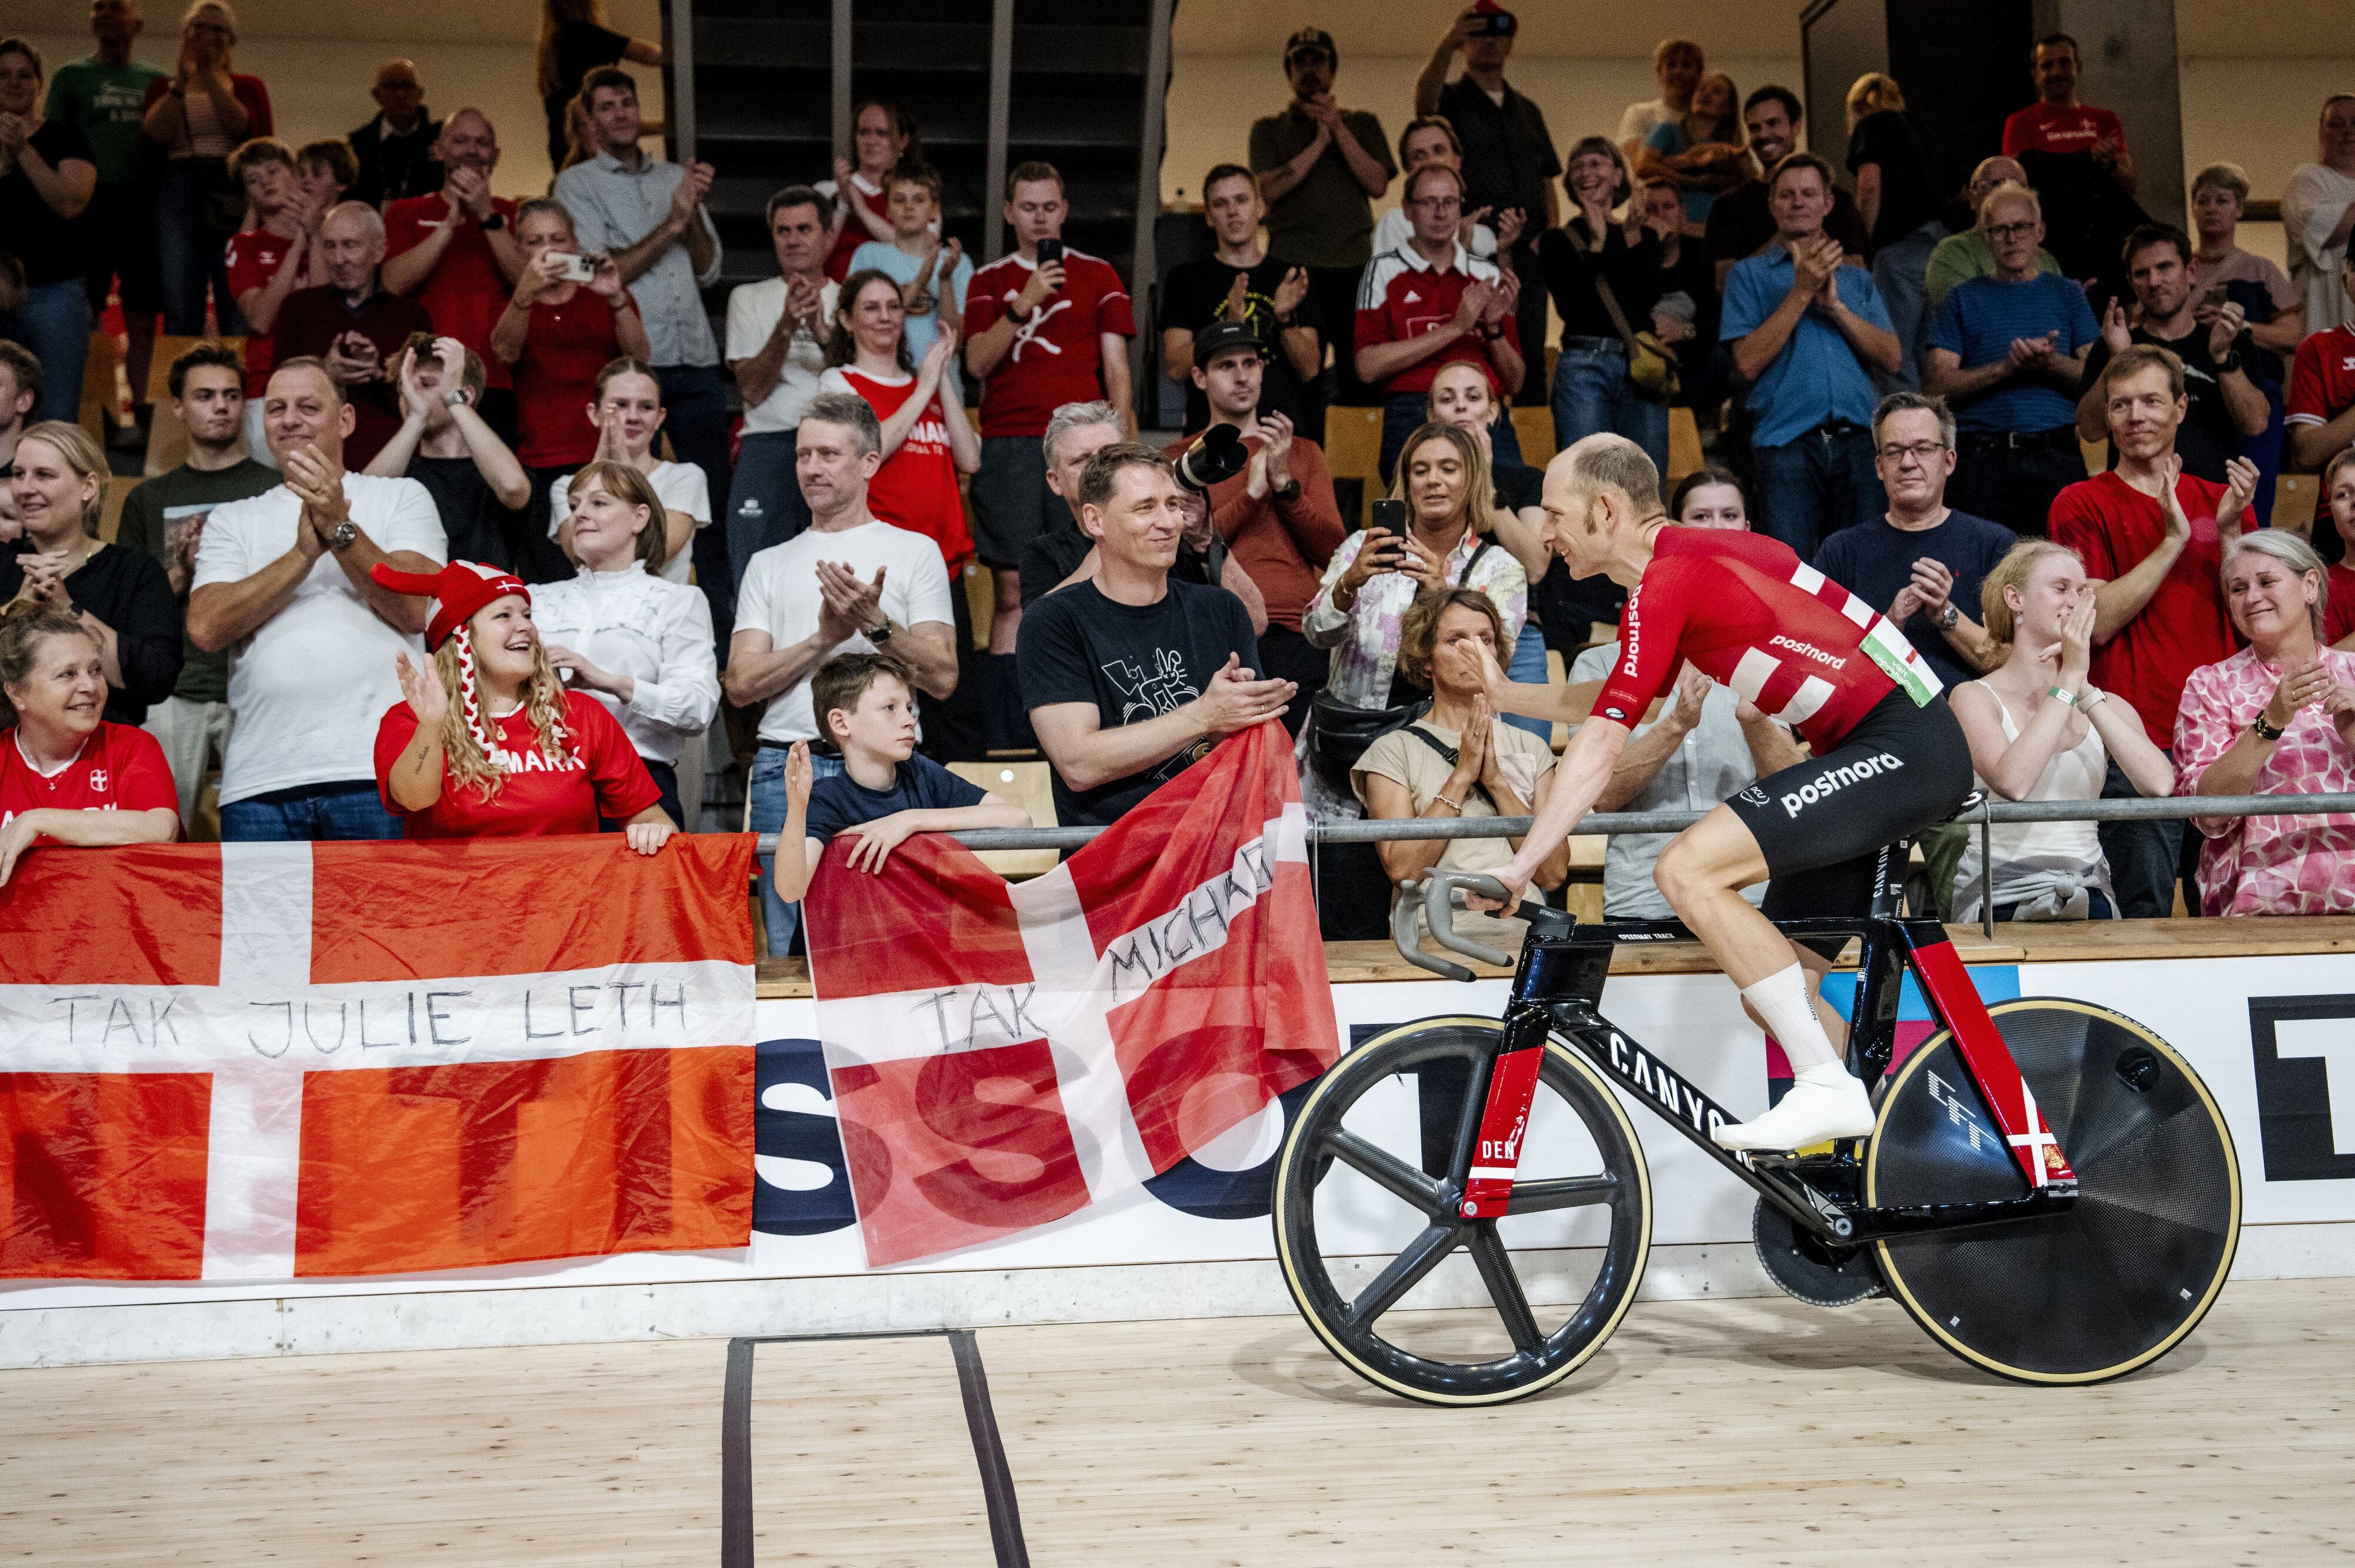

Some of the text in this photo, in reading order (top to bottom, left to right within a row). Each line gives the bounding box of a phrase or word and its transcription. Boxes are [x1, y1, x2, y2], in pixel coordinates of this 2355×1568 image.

[1769, 634, 1846, 670] postnord
[1892, 660, 1908, 677] visit
[1873, 653, 1915, 693] copenhagen
[1750, 786, 1766, 798] DCU
[1780, 752, 1905, 818] postnord
[1873, 845, 1889, 898] CANYON
[47, 978, 686, 1058] TAK JULIE LETH
[910, 984, 1050, 1051] TAK
[1803, 988, 1818, 1021] FUSION
[1482, 1141, 1515, 1159] DEN
